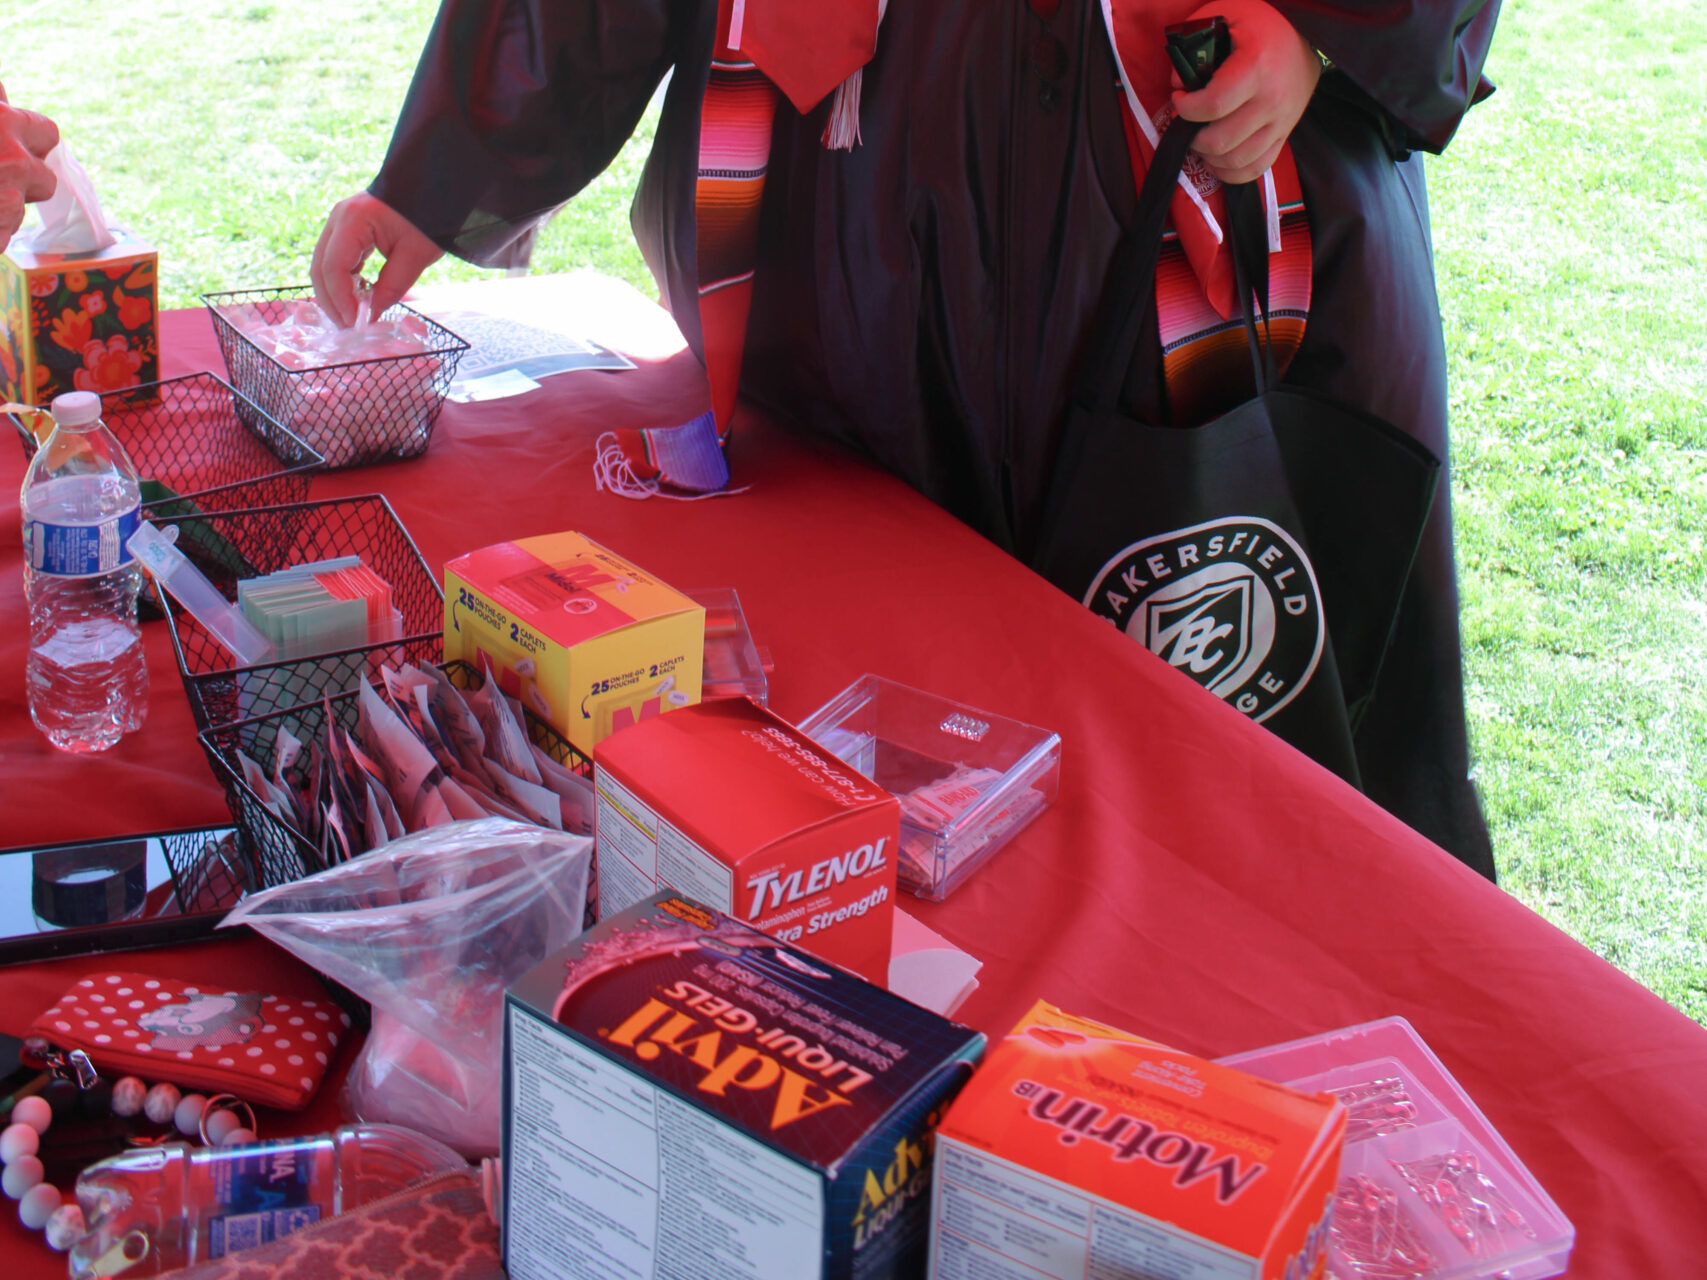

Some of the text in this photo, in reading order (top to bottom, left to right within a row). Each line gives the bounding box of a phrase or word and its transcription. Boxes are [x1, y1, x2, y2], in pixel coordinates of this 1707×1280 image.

[459, 587, 475, 610] 25
[475, 597, 507, 624] ON-THE-GO
[474, 606, 502, 631] POUCHES
[510, 622, 547, 652] 2 CAPLETS
[519, 637, 537, 655] EACH
[649, 655, 685, 678] 2 CAPLETS
[658, 665, 676, 676] EACH
[591, 668, 645, 696] 25 ON-THE-GO
[609, 676, 640, 690] POUCHES
[740, 729, 857, 807] How can we help?
[746, 836, 888, 922] TYLENOL
[755, 905, 806, 930] taminophen
[775, 925, 804, 942] tra
[807, 884, 889, 934] Strength
[607, 995, 855, 1131] Advil
[1013, 1079, 1041, 1102] IB
[1029, 1089, 1267, 1206] Motrin
[1181, 1119, 1275, 1161] Ibuprofen
